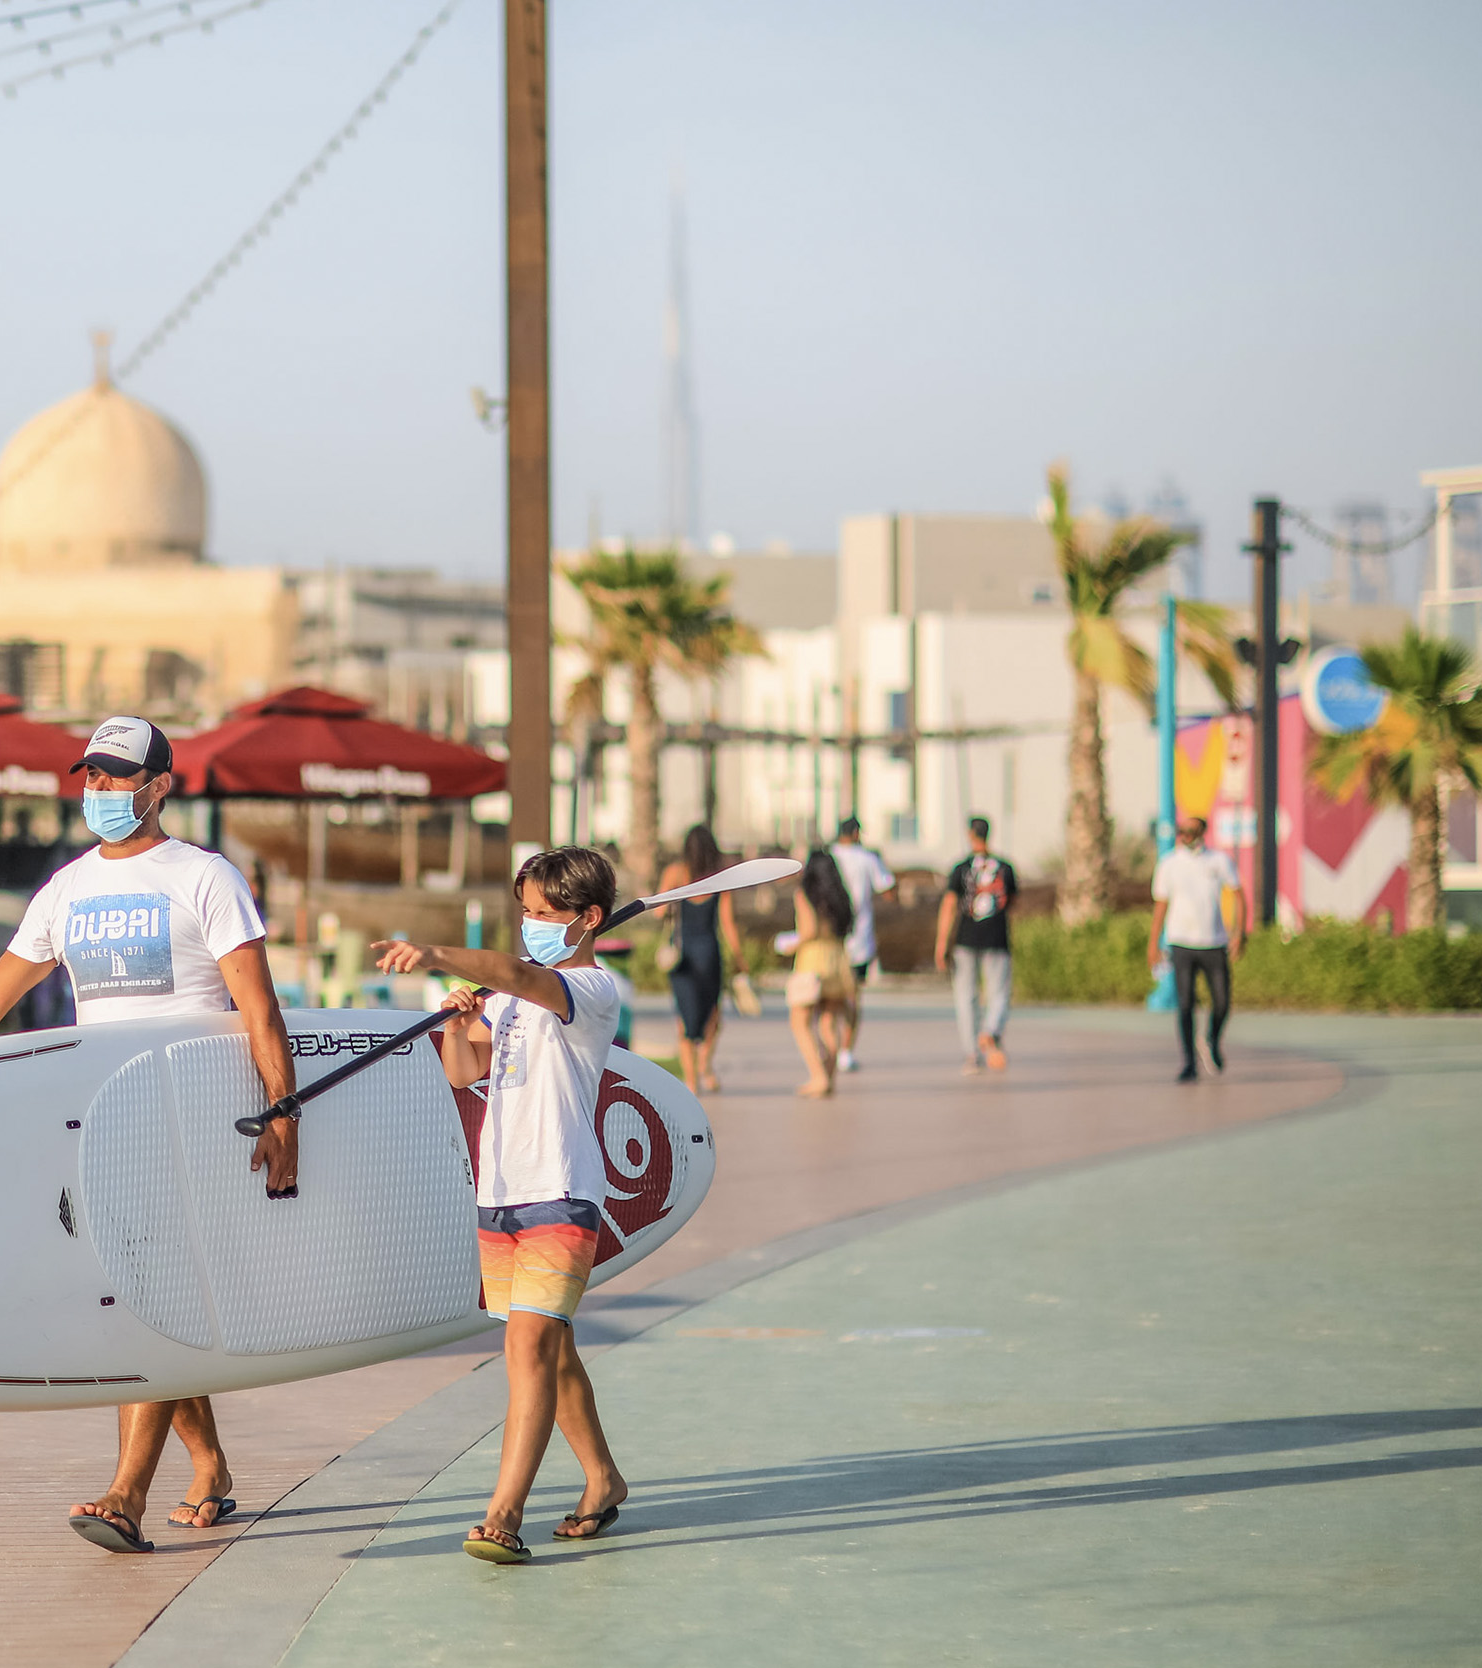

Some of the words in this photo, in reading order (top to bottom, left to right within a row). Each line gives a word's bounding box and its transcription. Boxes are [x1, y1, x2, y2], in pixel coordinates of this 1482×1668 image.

[69, 908, 160, 945] DUBAI
[81, 947, 109, 960] SINCE
[123, 946, 144, 957] 1971
[100, 981, 120, 990] ARAB
[121, 979, 162, 988] EMIRATES
